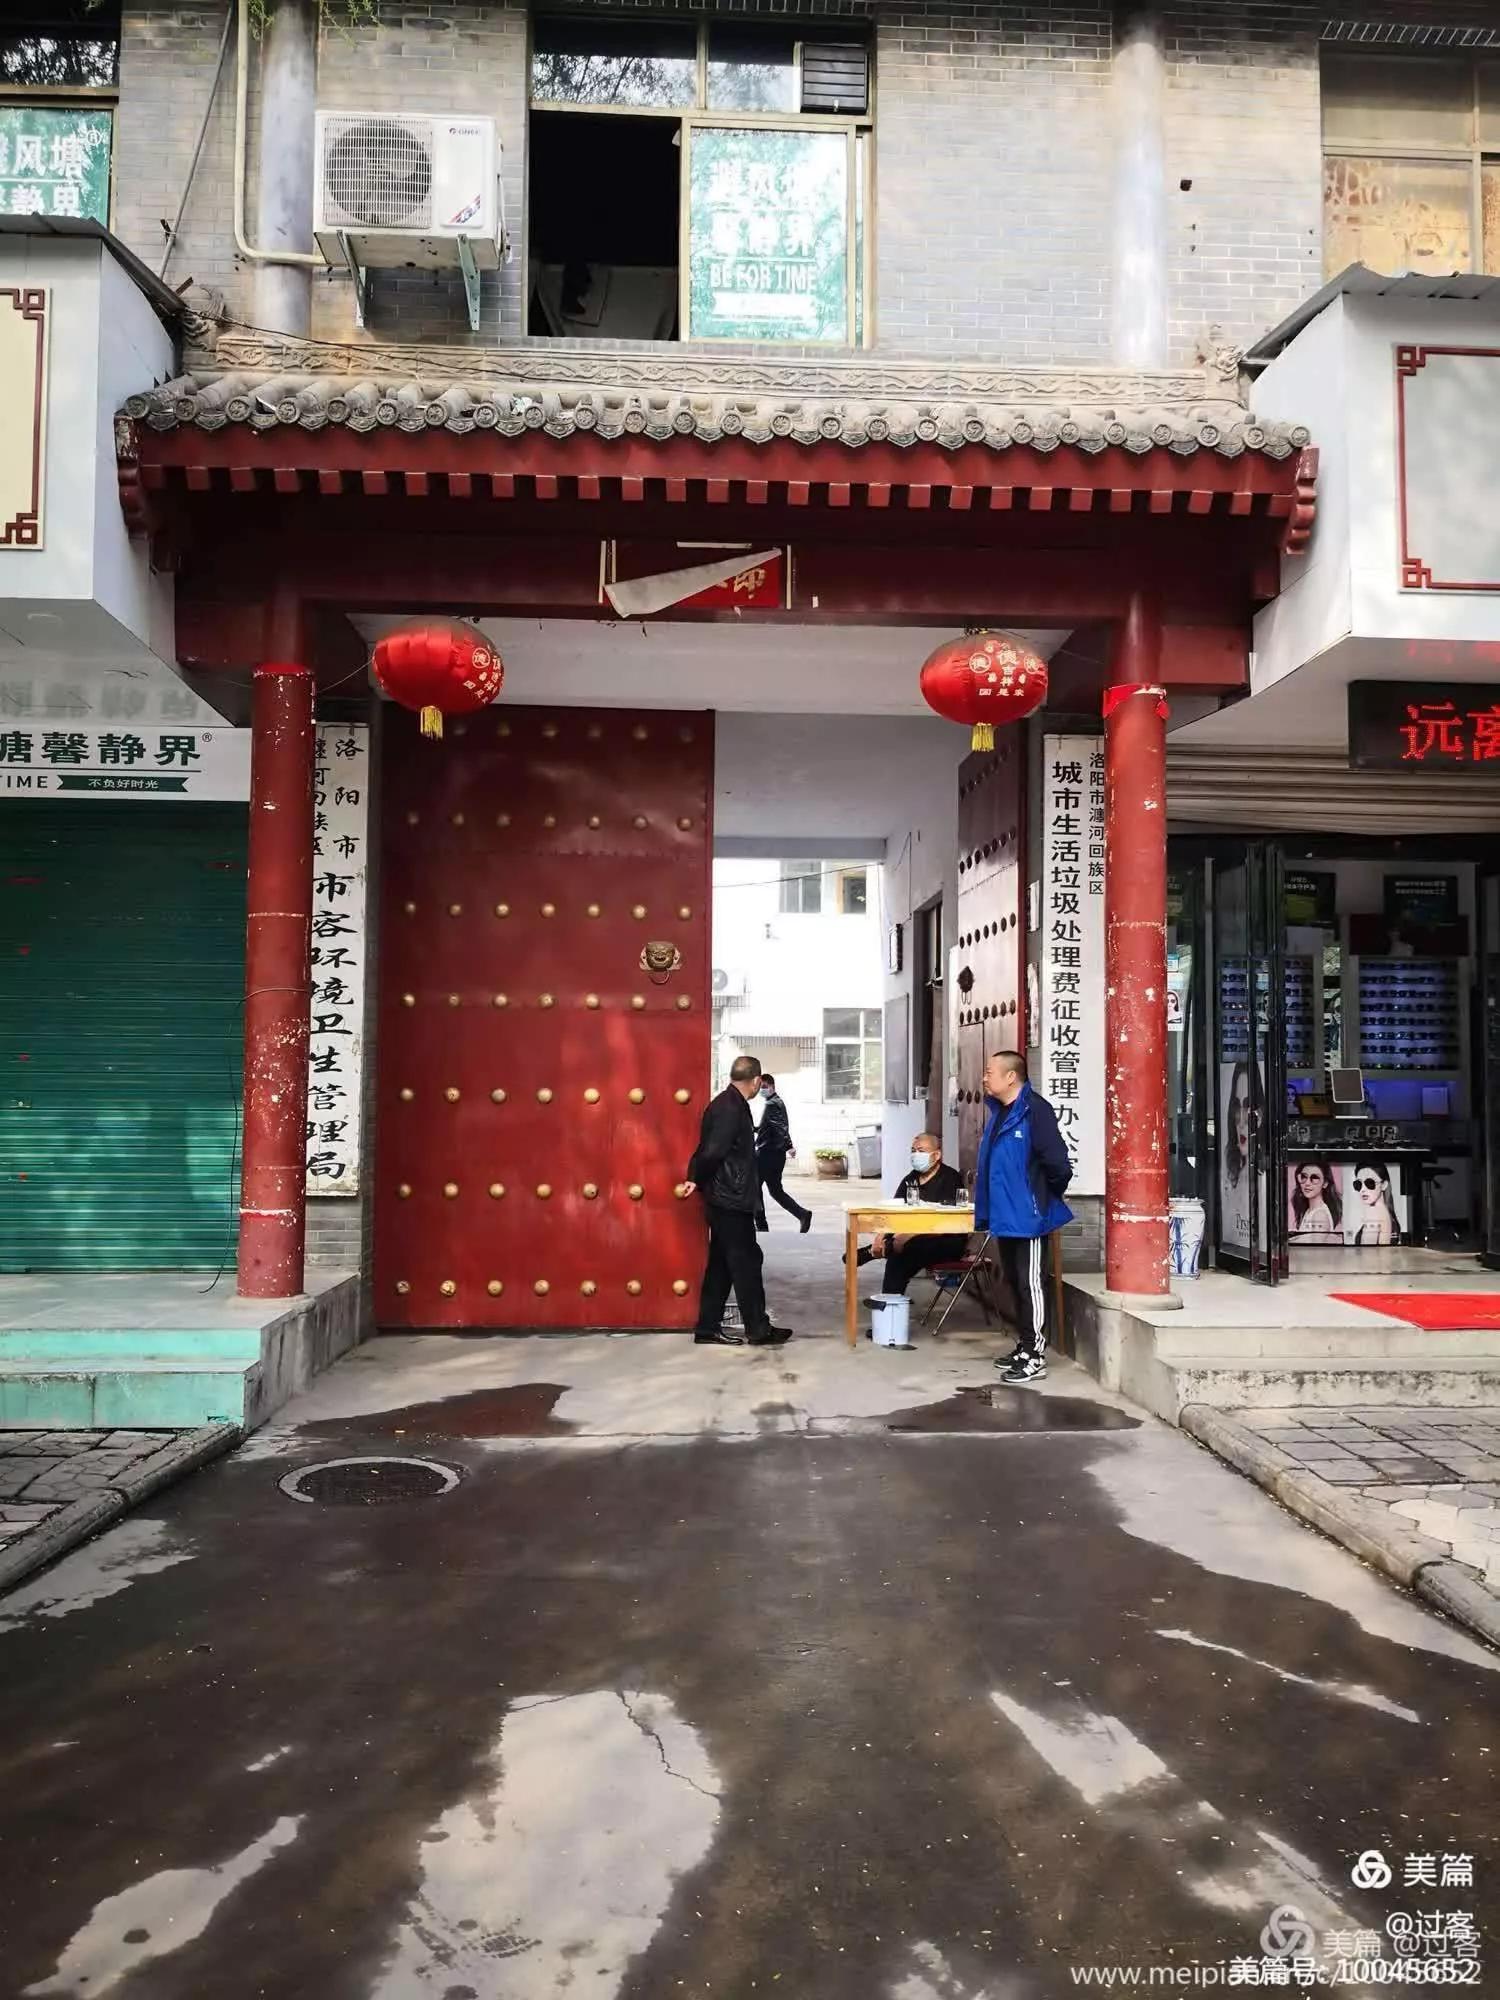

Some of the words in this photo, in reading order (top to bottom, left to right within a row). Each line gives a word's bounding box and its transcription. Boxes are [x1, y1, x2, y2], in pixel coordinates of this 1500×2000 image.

[0, 775, 48, 789] IME
[88, 778, 159, 790] 不负好时光
[333, 738, 364, 860] 洛阳市
[1049, 761, 1083, 1178] 城市生活垃圾处理费征收管理办
